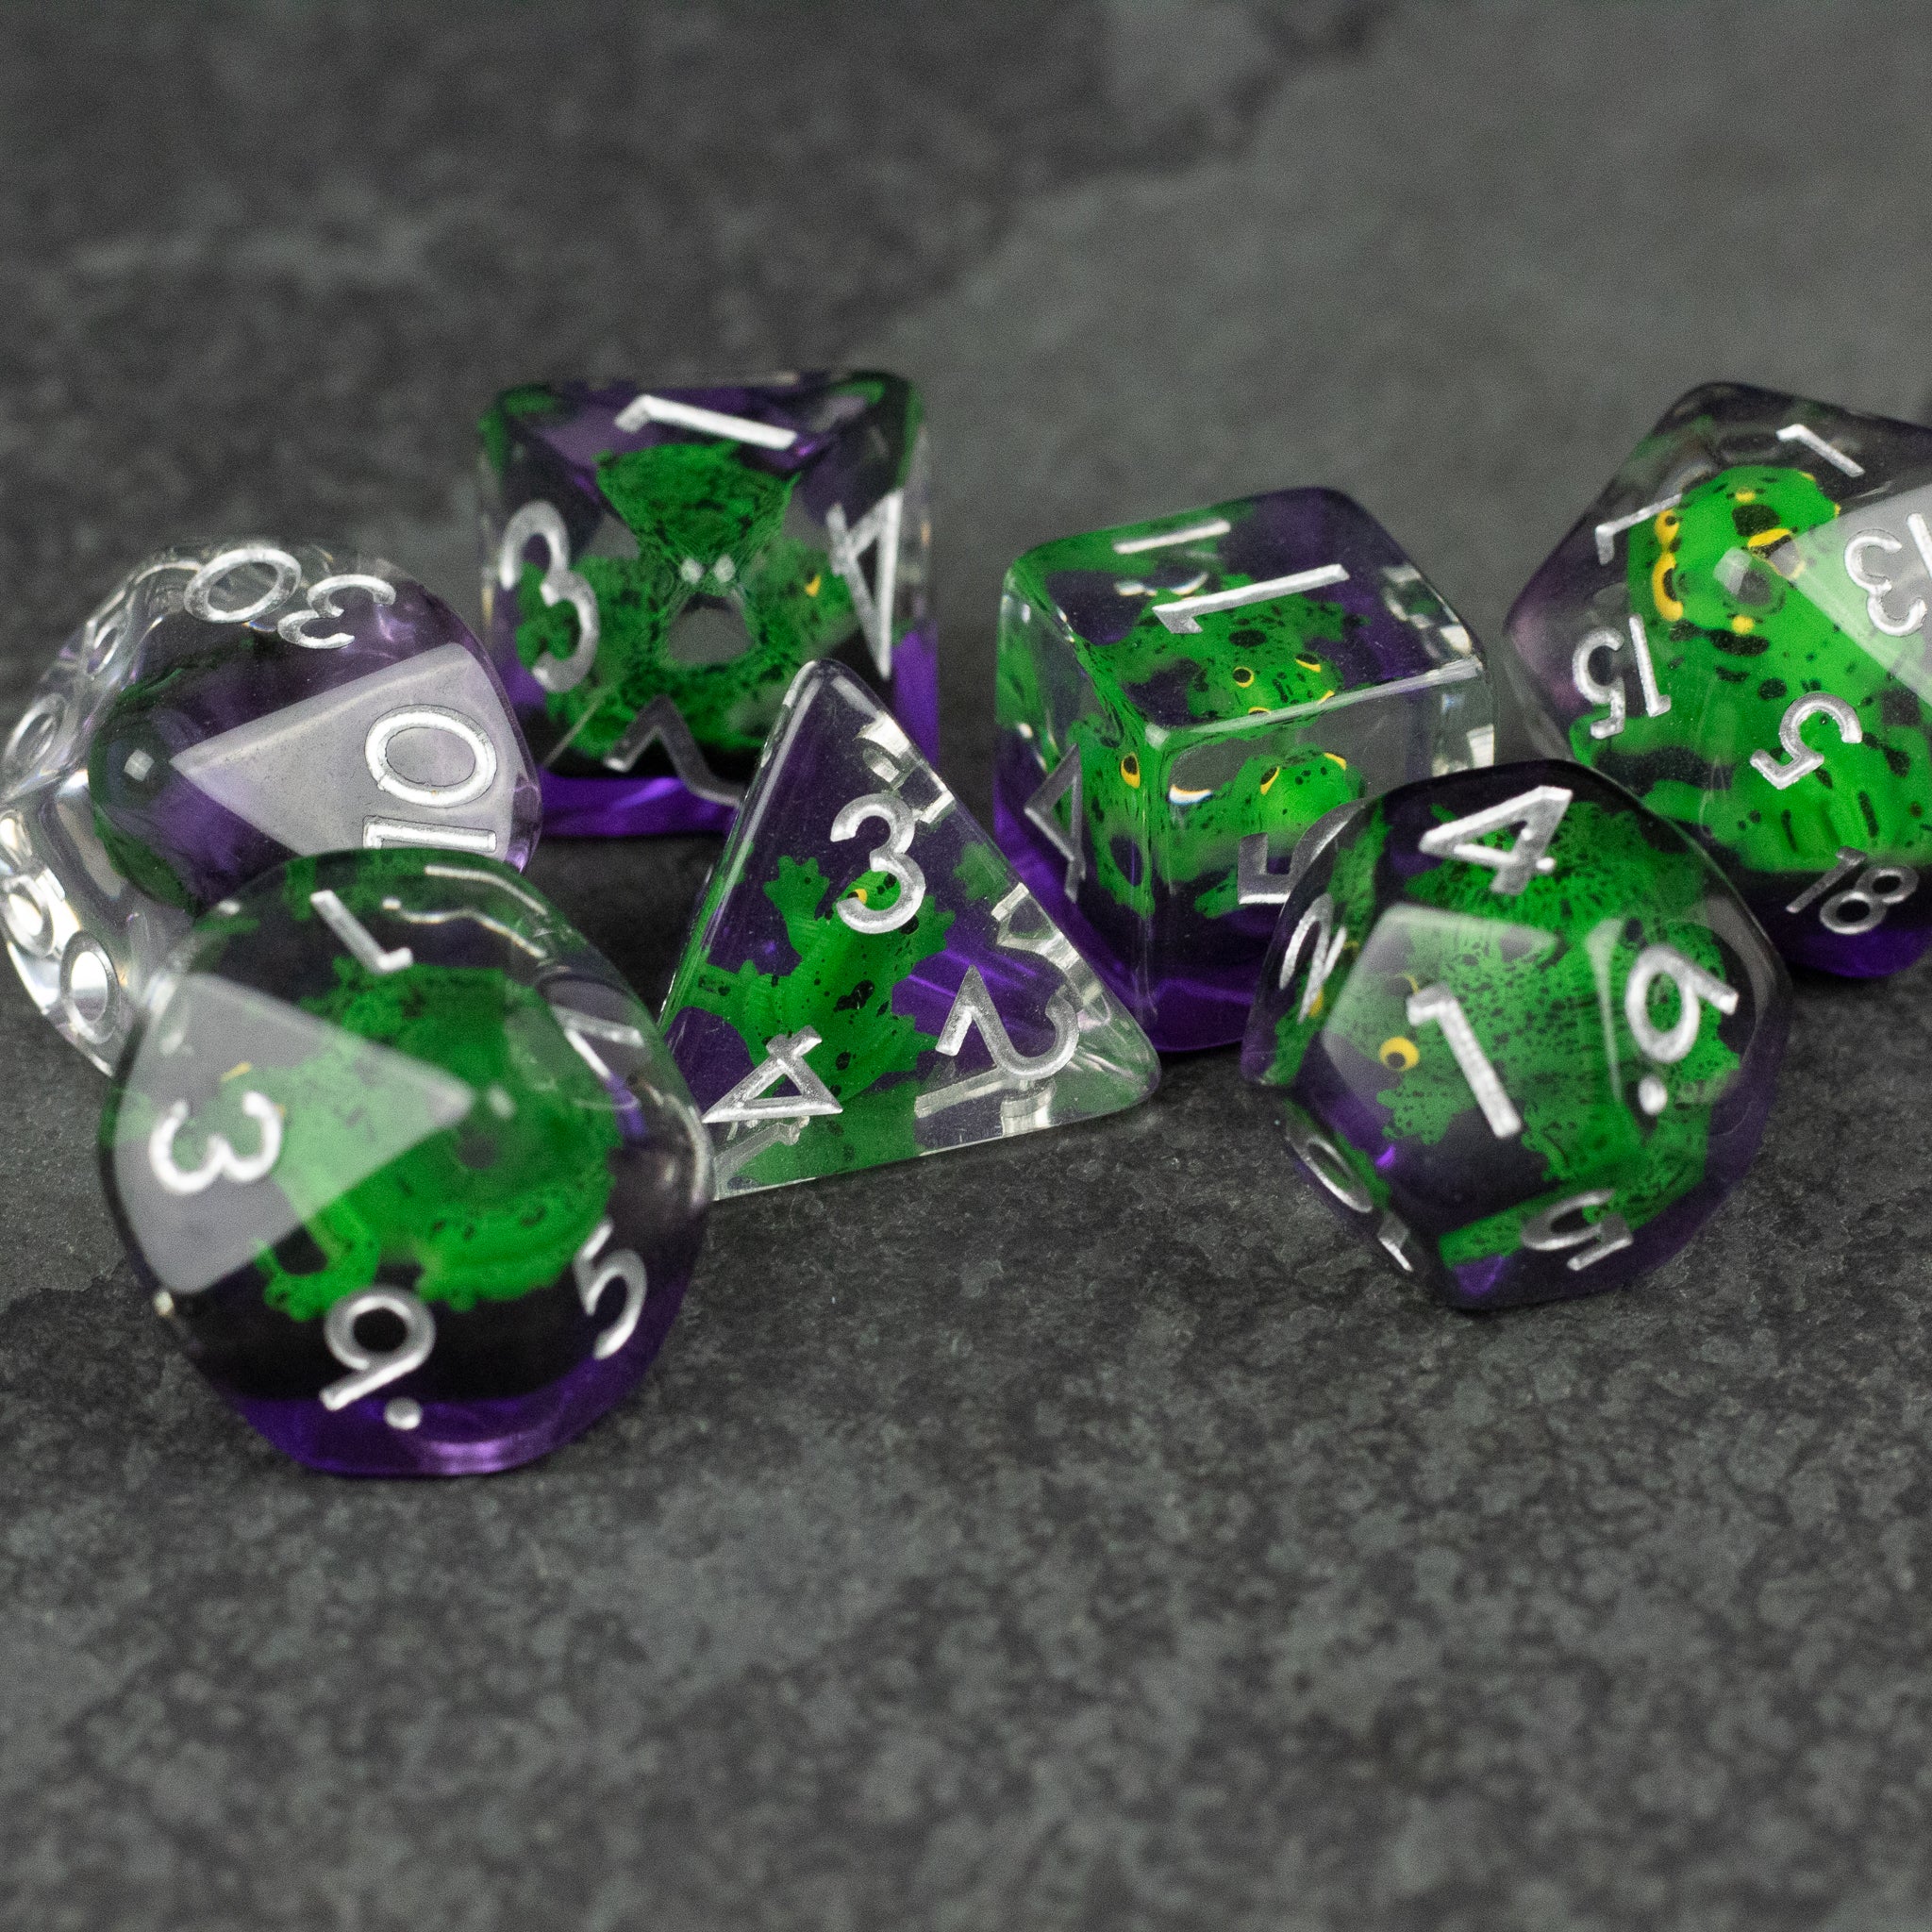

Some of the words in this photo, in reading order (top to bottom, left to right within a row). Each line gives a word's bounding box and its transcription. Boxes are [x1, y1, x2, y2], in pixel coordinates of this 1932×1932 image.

[614, 394, 798, 449] 1
[1777, 424, 1865, 476] 1
[184, 547, 395, 649] 30
[499, 501, 599, 693] 3
[824, 488, 903, 679] 4
[1152, 564, 1350, 634] 1
[1574, 615, 1671, 740] 15
[1750, 692, 1863, 790] 5
[830, 792, 926, 934] 3
[1024, 741, 1086, 904] 4
[1418, 785, 1574, 896] 4
[309, 891, 415, 973] 1
[1786, 846, 1920, 935] 18
[701, 1024, 843, 1124] 4
[935, 964, 1081, 1081] 2
[1407, 983, 1522, 1139] 1
[148, 1091, 281, 1194] 3
[574, 1223, 648, 1360] 5
